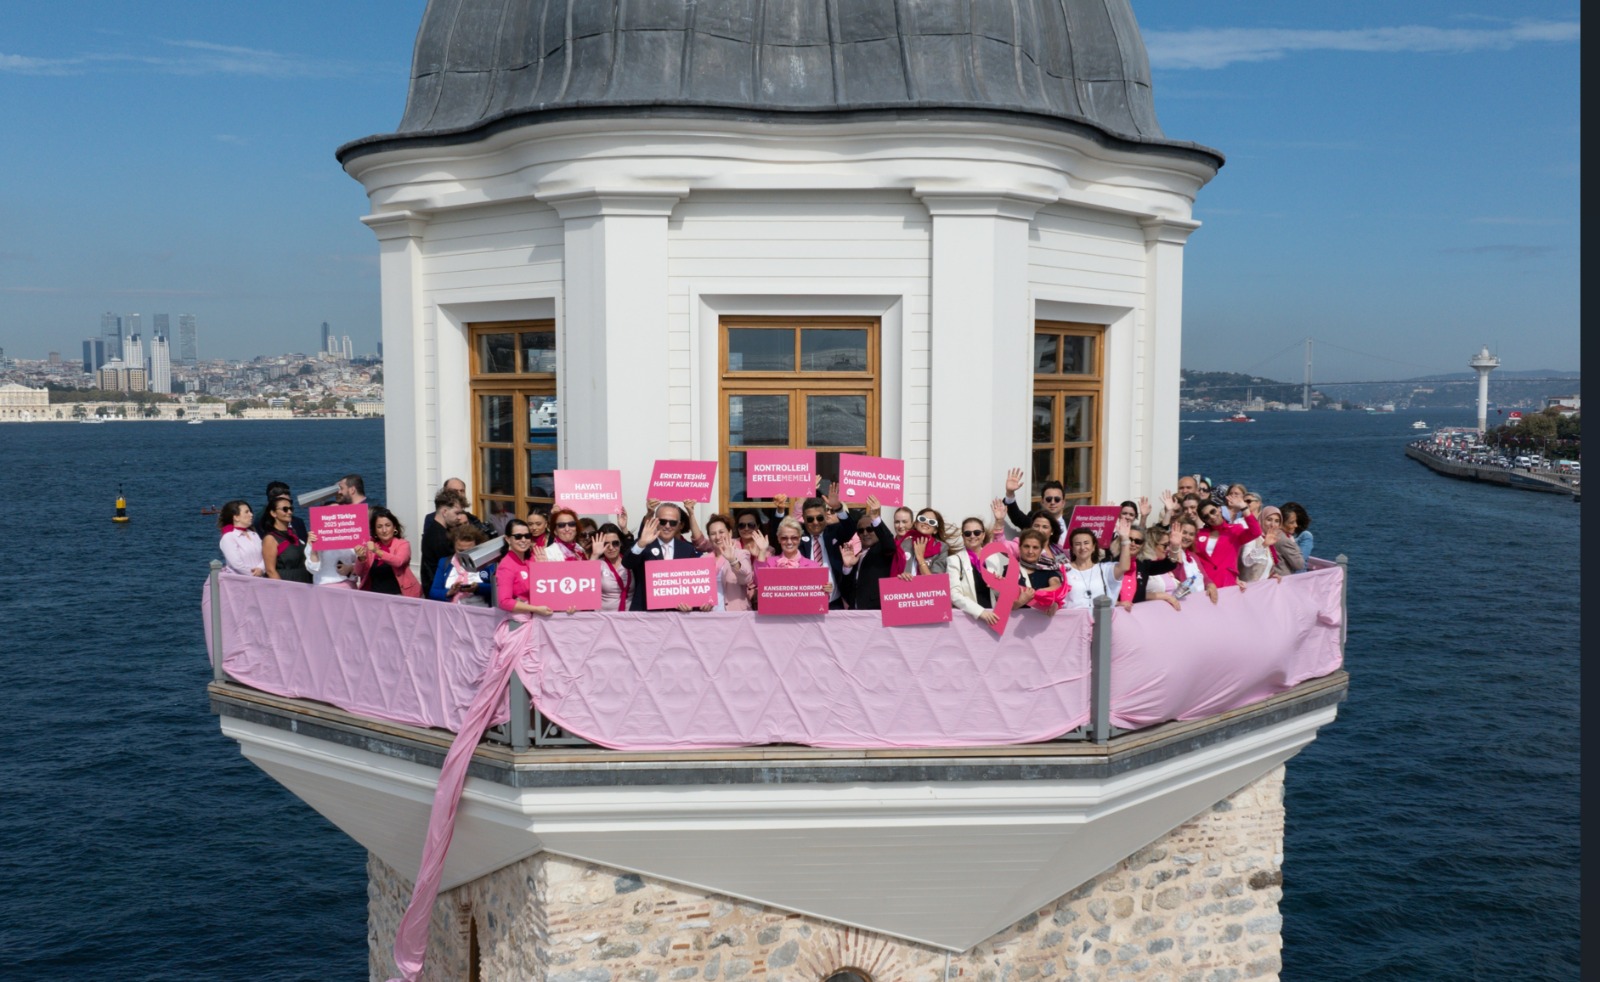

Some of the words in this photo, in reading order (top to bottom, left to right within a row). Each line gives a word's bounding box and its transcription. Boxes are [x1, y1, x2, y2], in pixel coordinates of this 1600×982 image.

[754, 462, 809, 472] KONTROLLERİ
[752, 472, 811, 482] ERTELEMEMELİ
[844, 470, 876, 479] FARKINDA
[878, 473, 901, 482] OLMAK
[844, 476, 866, 486] ÖNLEM
[868, 481, 901, 490] ALMAKTIR
[560, 491, 618, 500] ERTELEMEMELİ
[670, 568, 710, 578] KONTROLÜNÜ
[536, 577, 596, 594] STOP!
[652, 578, 682, 586] DÜZENLİ
[682, 577, 710, 585] OLARAK
[653, 585, 690, 596] KENDİN
[691, 585, 711, 595] YAP
[884, 592, 914, 601] KORKMA
[916, 590, 947, 598] UNUTMA
[898, 599, 934, 608] ERTELEME
